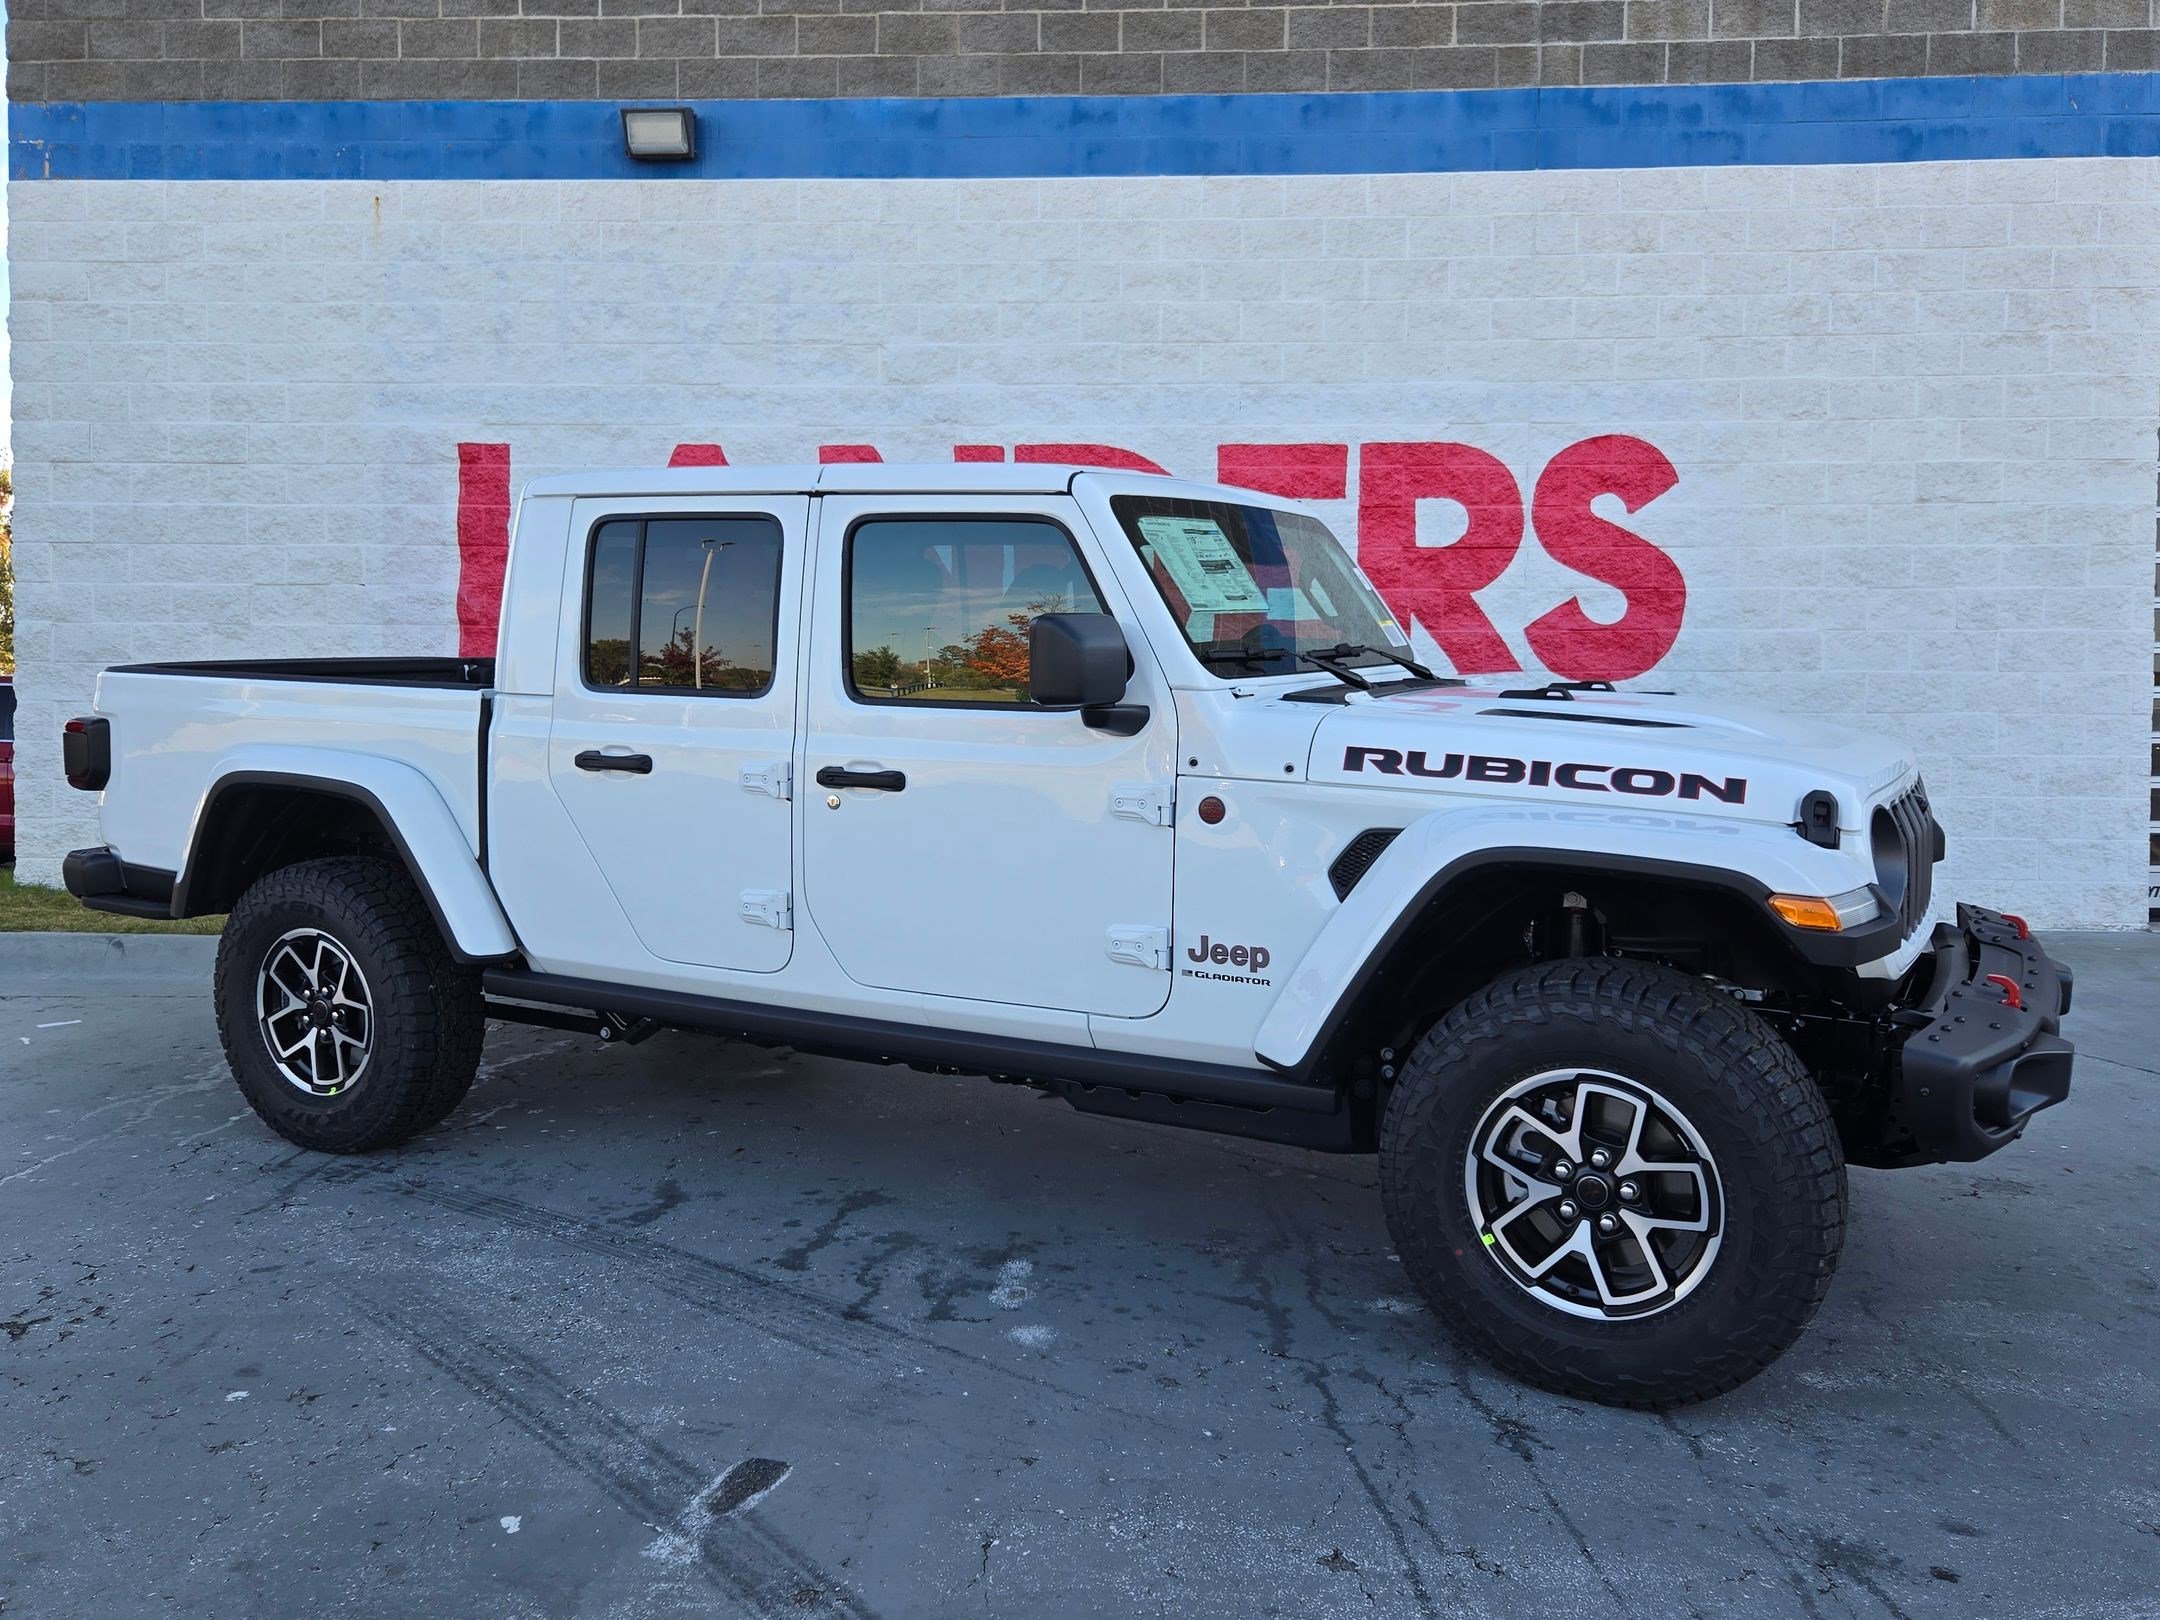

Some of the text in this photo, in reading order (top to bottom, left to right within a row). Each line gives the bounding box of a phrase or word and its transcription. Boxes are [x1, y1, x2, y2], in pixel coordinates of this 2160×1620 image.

[1343, 746, 1748, 804] RUBICON
[1188, 935, 1270, 973] Jeep
[1195, 971, 1271, 987] GLADIATOR
